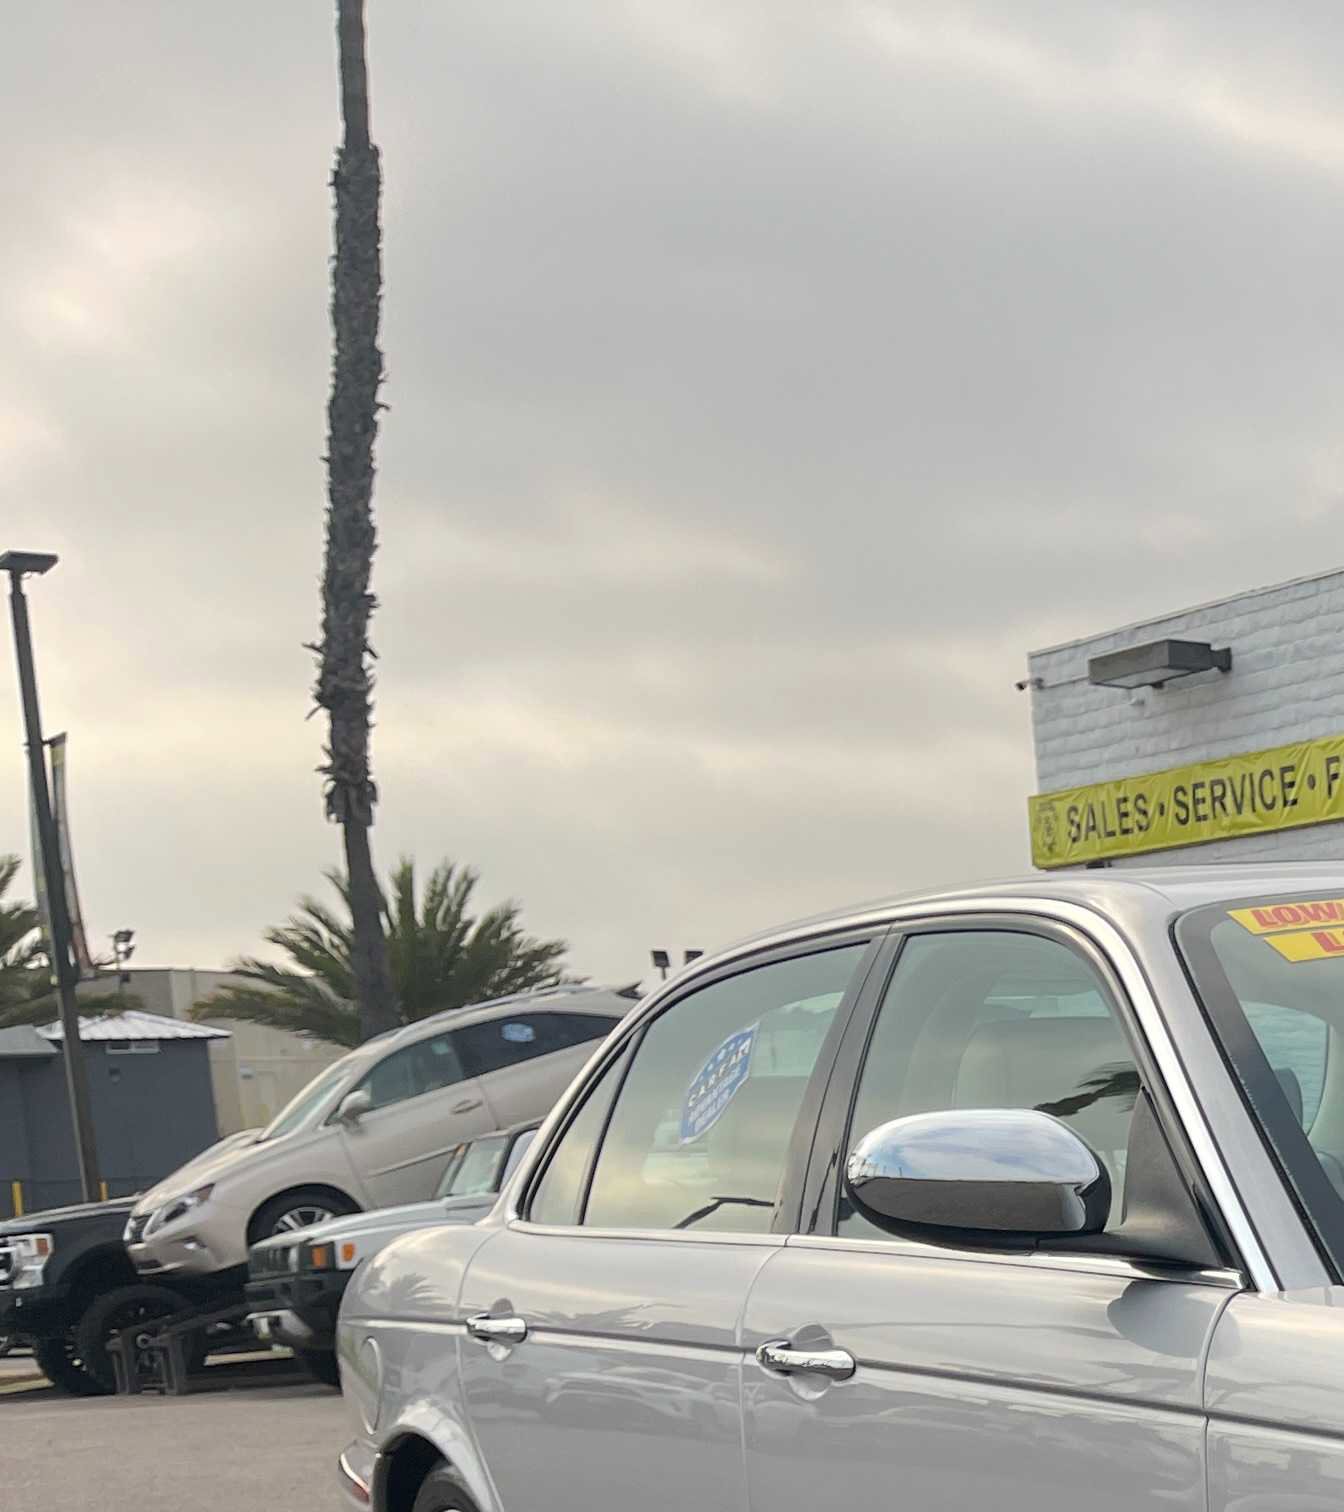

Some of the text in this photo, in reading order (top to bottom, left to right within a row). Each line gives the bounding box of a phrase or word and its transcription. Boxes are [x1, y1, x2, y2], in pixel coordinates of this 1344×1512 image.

[1067, 793, 1150, 843] SALES
[1173, 765, 1298, 826] SERVICE
[1250, 902, 1343, 930] LOW
